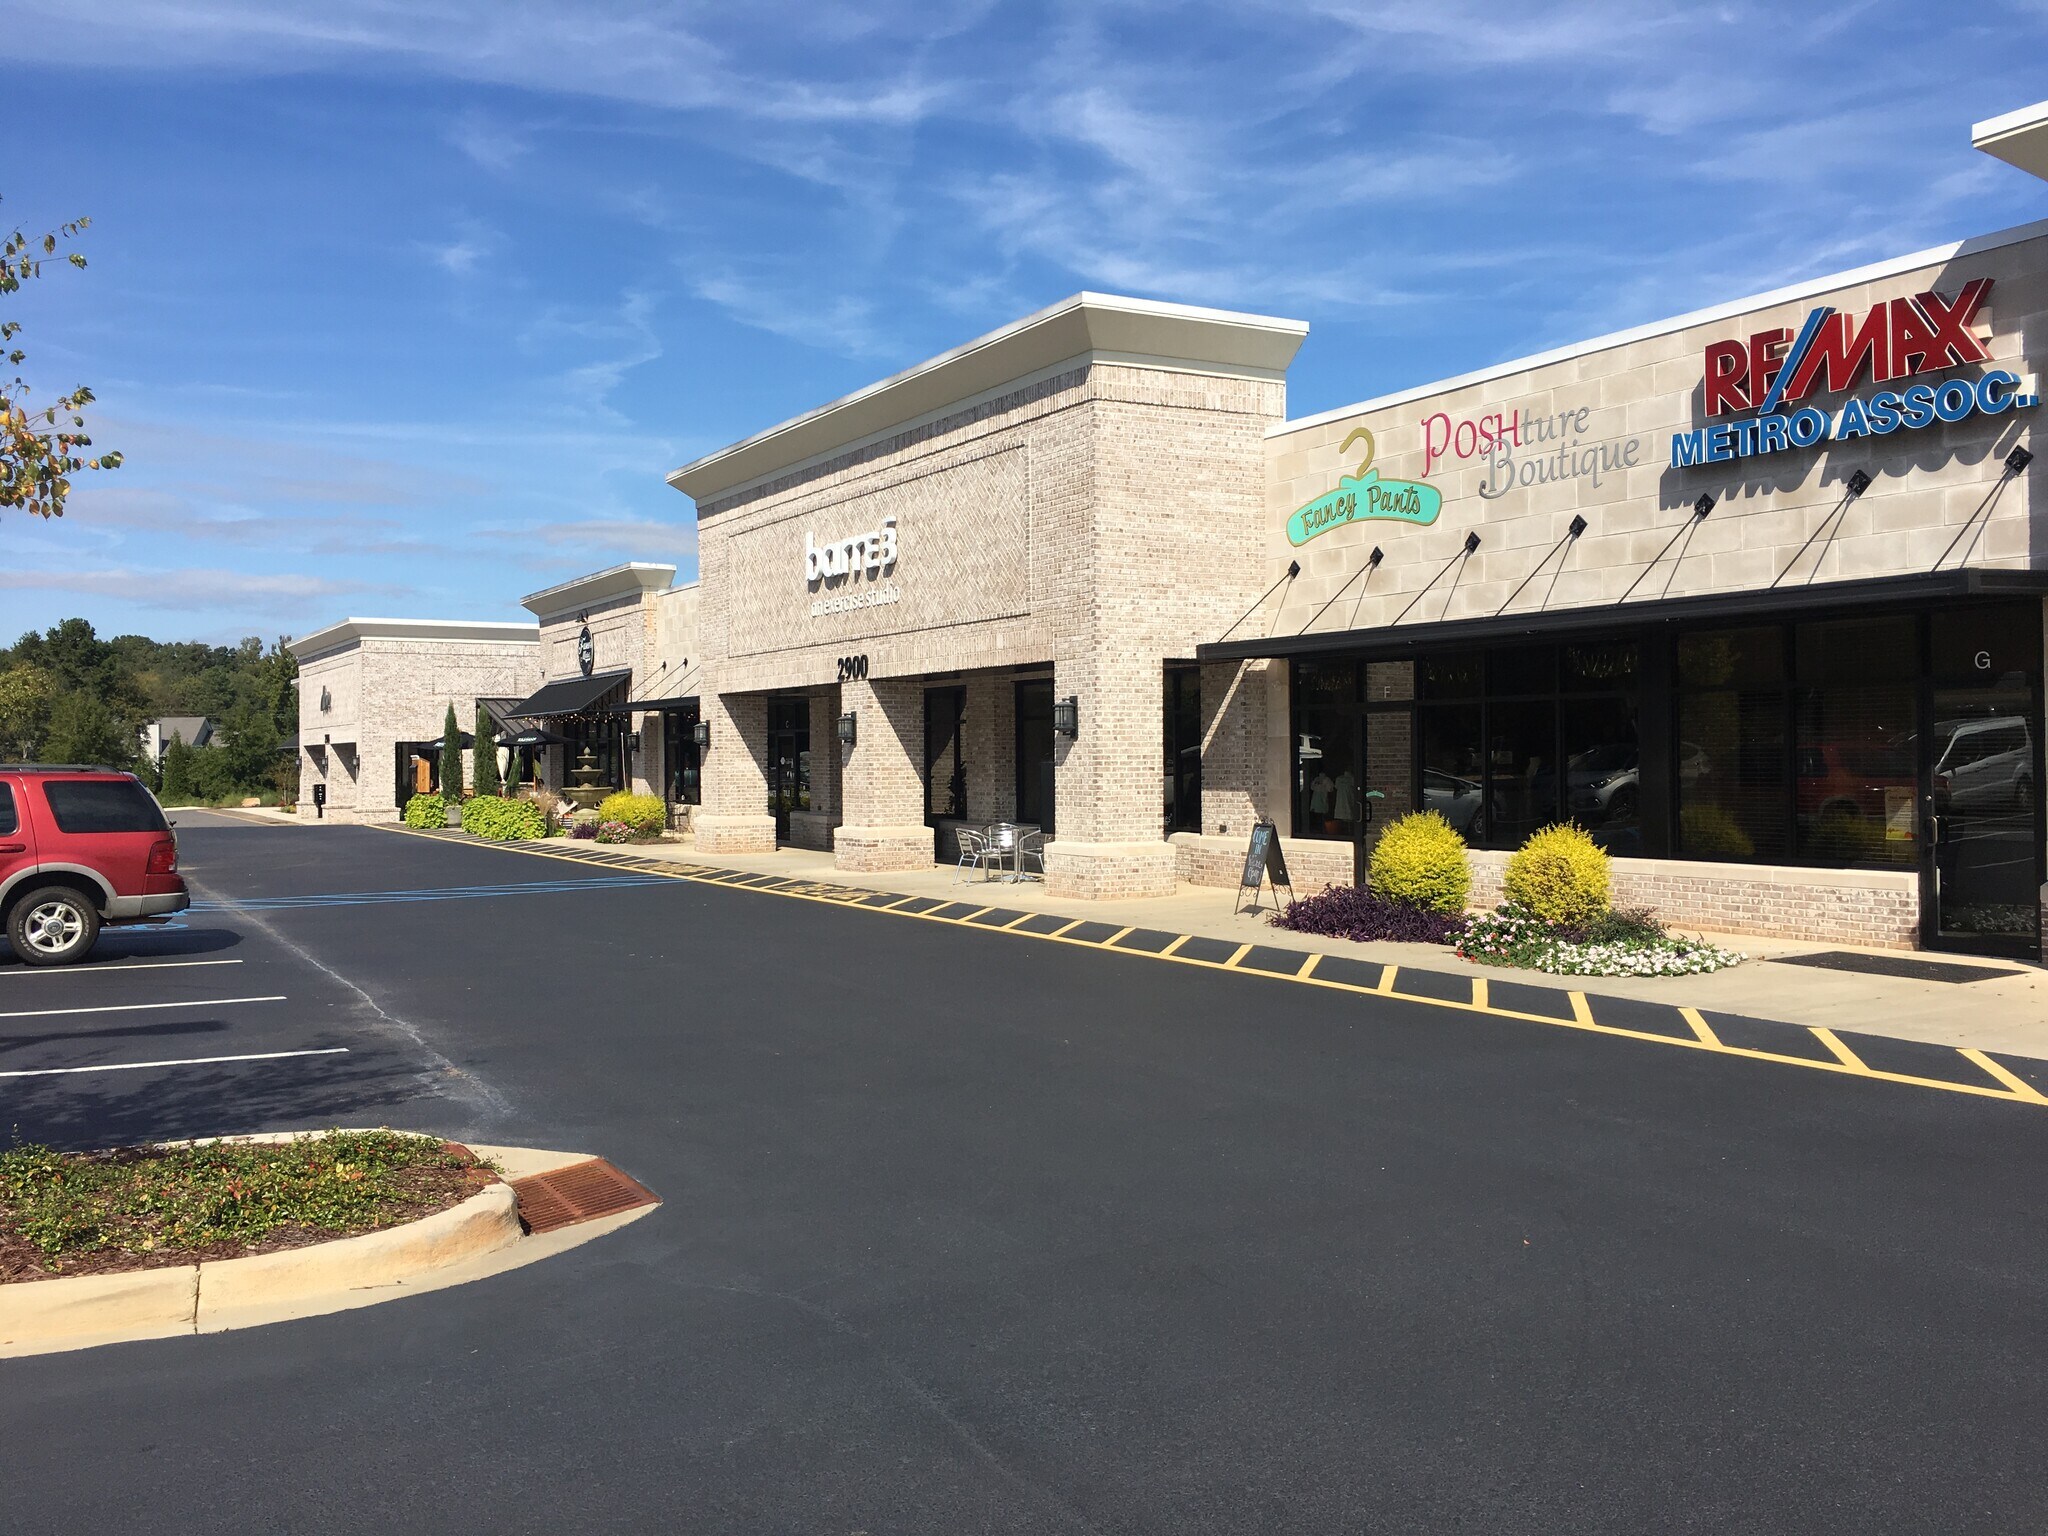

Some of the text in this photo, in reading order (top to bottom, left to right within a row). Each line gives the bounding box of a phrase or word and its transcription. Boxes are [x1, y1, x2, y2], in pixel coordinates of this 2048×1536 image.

[1703, 276, 1996, 416] RE/MAX
[1420, 406, 1591, 479] POSHture
[1670, 369, 2039, 470] METRO ASSOC.
[1478, 438, 1640, 500] Boutique
[1300, 485, 1421, 536] Fancy Pants
[866, 580, 900, 609] studio
[837, 654, 868, 682] 2900
[1974, 650, 1991, 670] G
[1383, 685, 1391, 699] F
